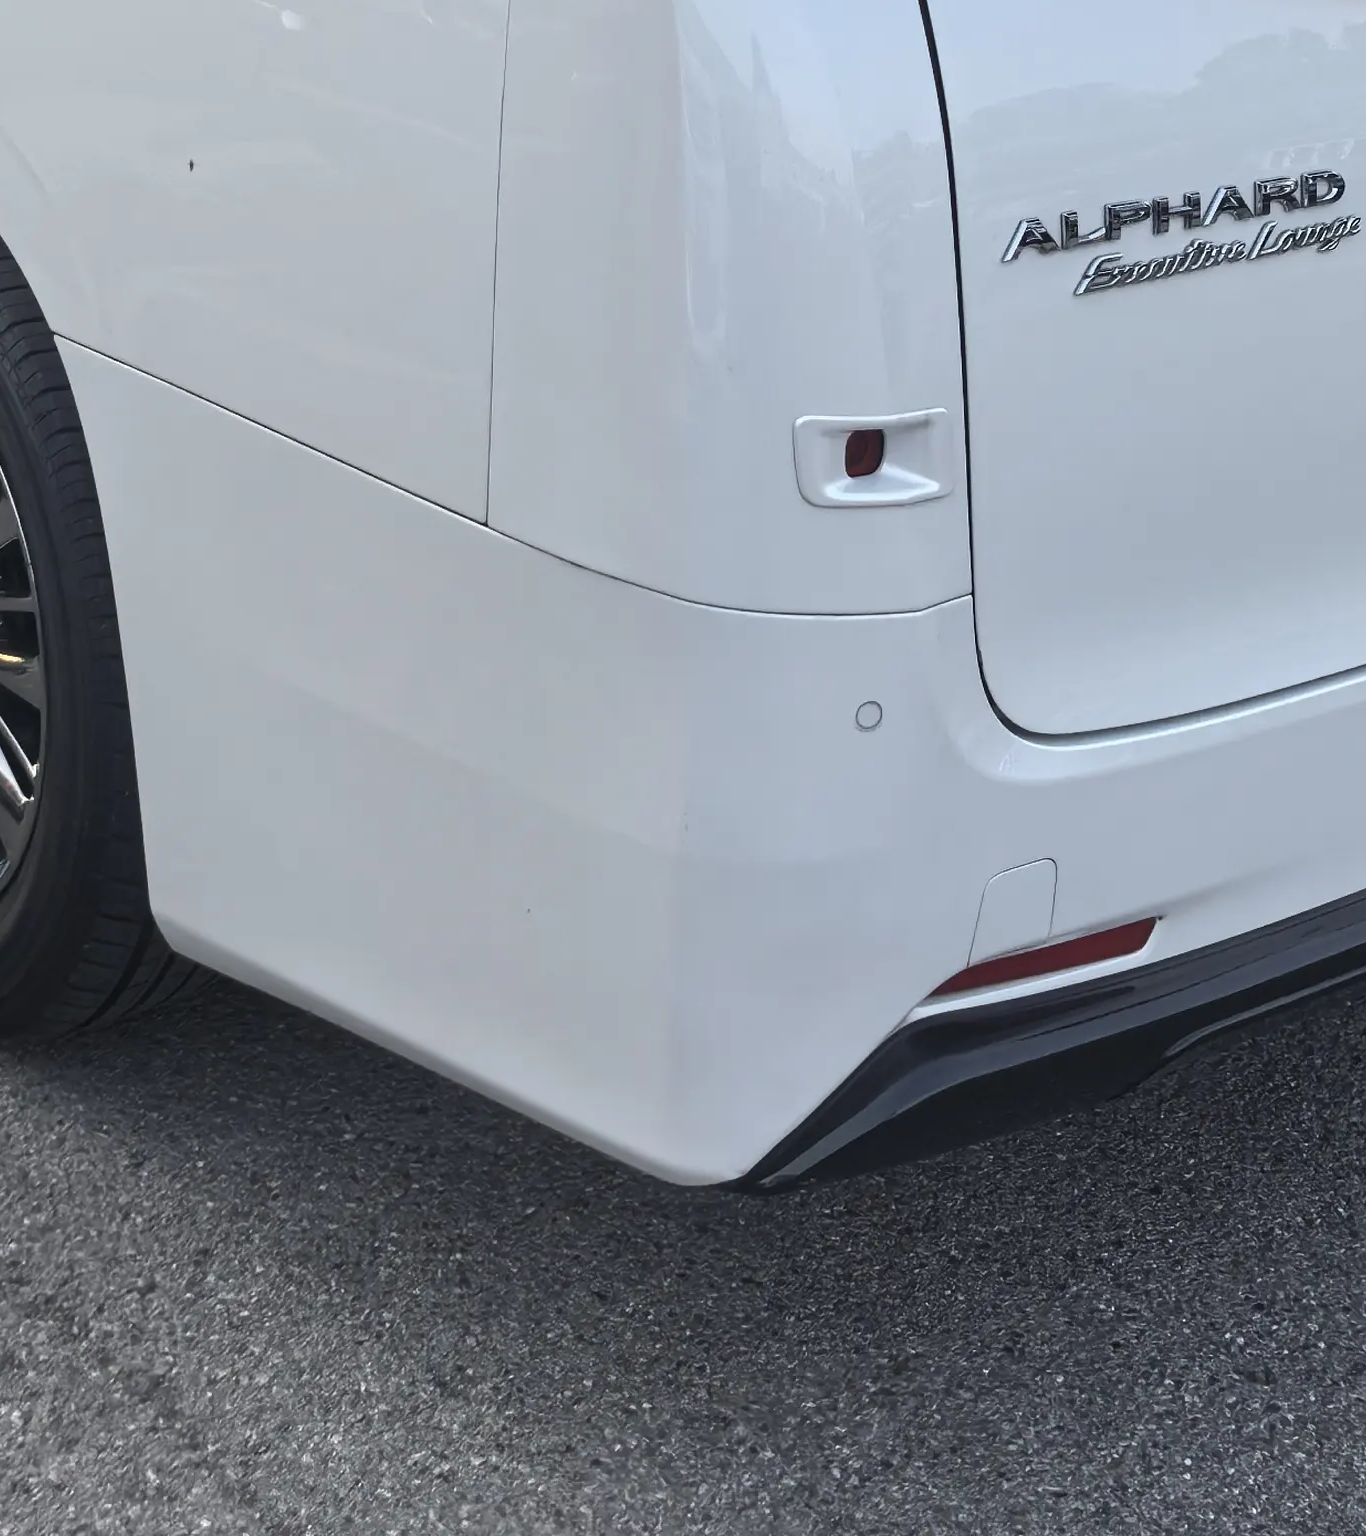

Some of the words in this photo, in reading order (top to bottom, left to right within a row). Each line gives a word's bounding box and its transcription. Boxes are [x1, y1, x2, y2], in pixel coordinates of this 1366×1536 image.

[1001, 169, 1347, 263] ALPHARD
[1072, 238, 1248, 297] Executive
[1245, 212, 1364, 263] Lounge
